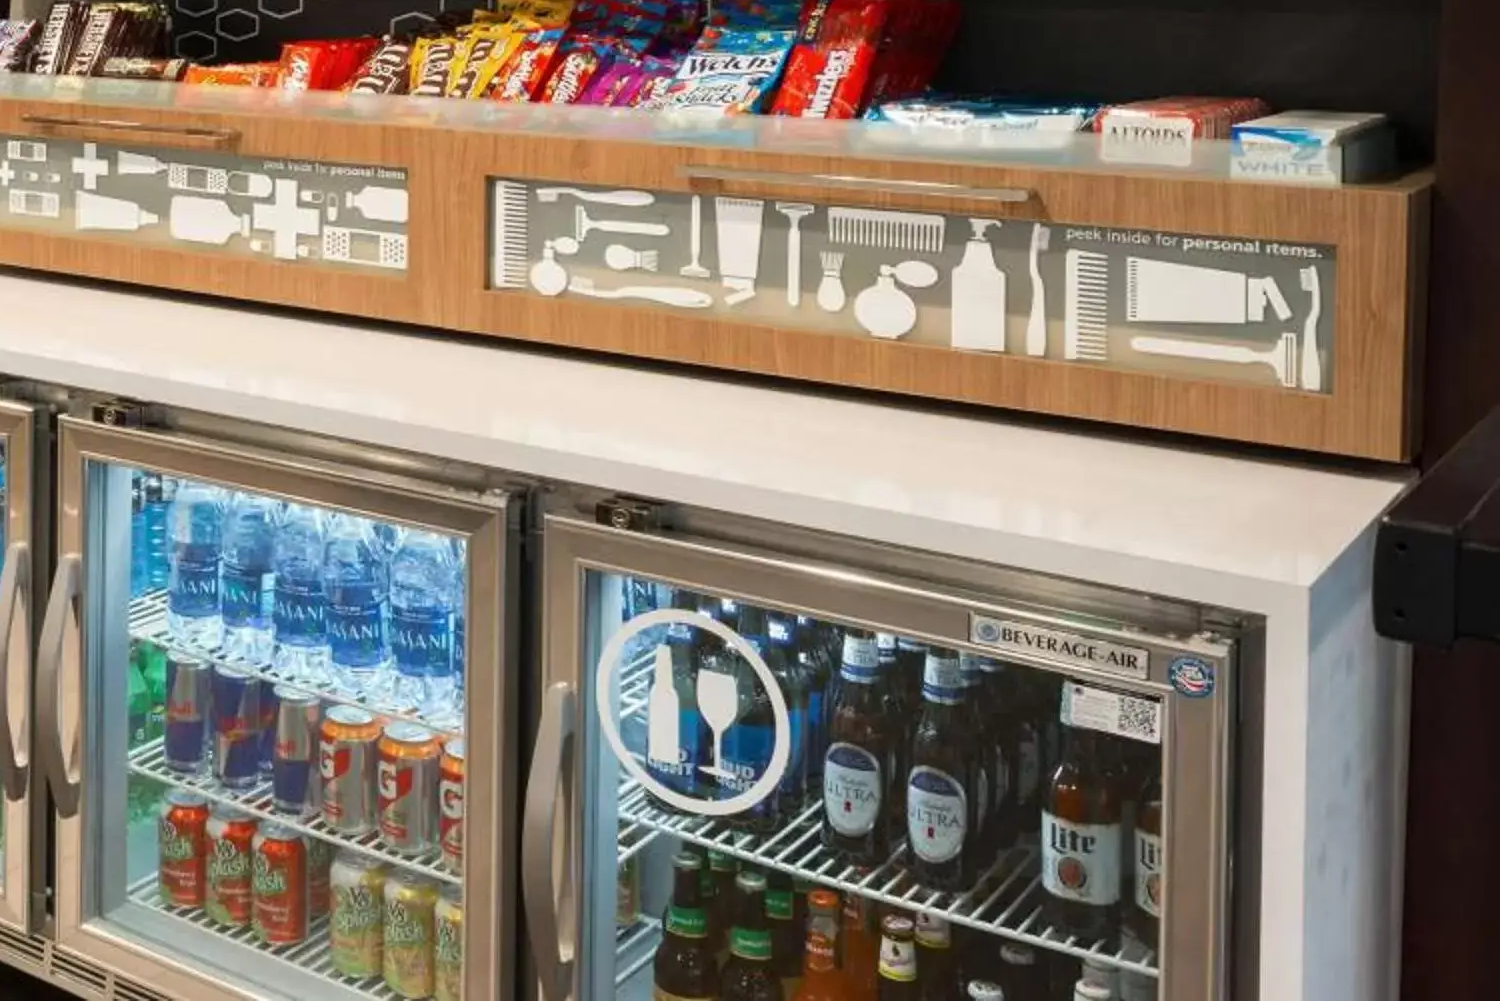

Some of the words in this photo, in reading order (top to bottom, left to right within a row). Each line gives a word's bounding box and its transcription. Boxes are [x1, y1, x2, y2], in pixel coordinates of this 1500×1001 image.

[1237, 159, 1326, 177] WHITE
[1065, 228, 1102, 243] peek
[1106, 229, 1151, 245] inside
[1155, 231, 1179, 247] for
[1182, 236, 1260, 254] personal
[1265, 242, 1324, 259] items.
[1001, 626, 1139, 670] BEVERAGE-AIR
[377, 760, 398, 799] G
[1051, 821, 1097, 855] Lite
